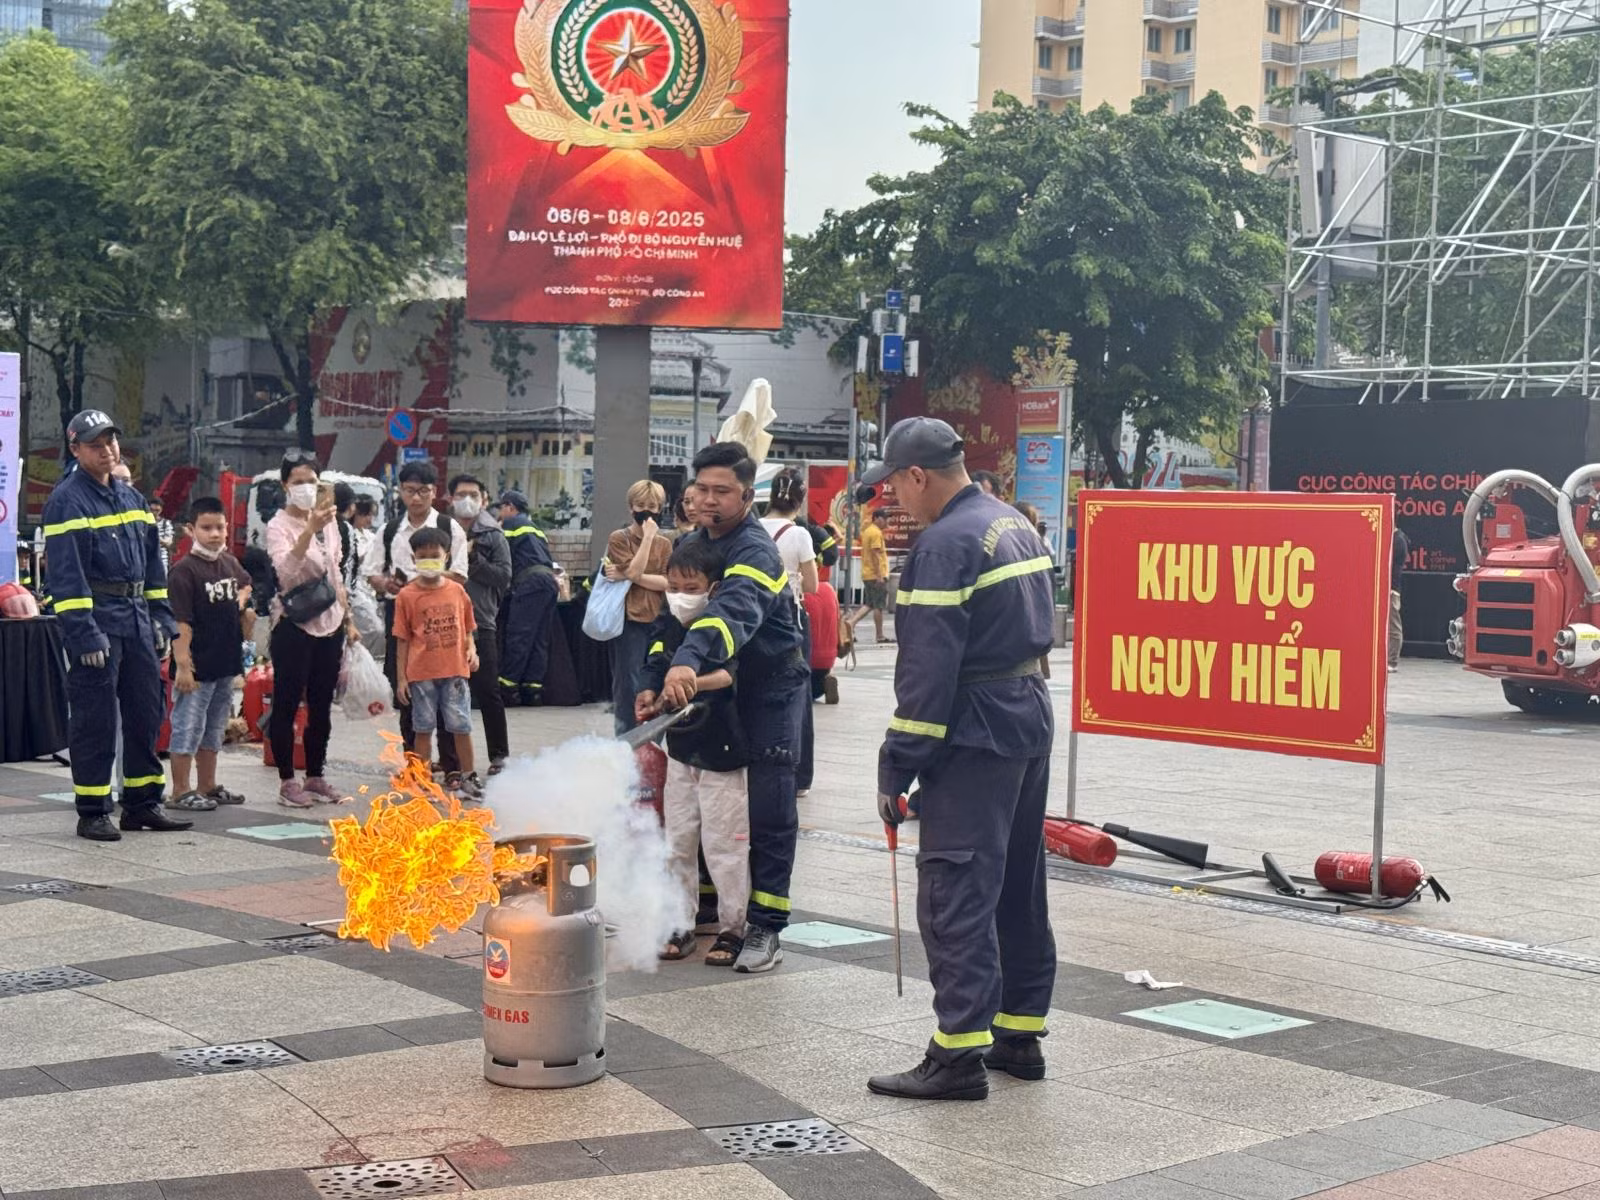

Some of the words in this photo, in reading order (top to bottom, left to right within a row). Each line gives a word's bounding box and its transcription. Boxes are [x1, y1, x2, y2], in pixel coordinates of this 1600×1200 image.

[546, 206, 590, 225] 06/6
[607, 208, 705, 227] 08/6/2025
[85, 412, 109, 427] 114
[1340, 472, 1396, 490] CÔNG
[1399, 471, 1437, 490] TÁC
[1138, 542, 1218, 603] KHU
[1231, 540, 1315, 620] VỰC
[1112, 634, 1218, 699] NGUY
[1231, 620, 1341, 711] HIỂM
[505, 1009, 529, 1024] GAS
